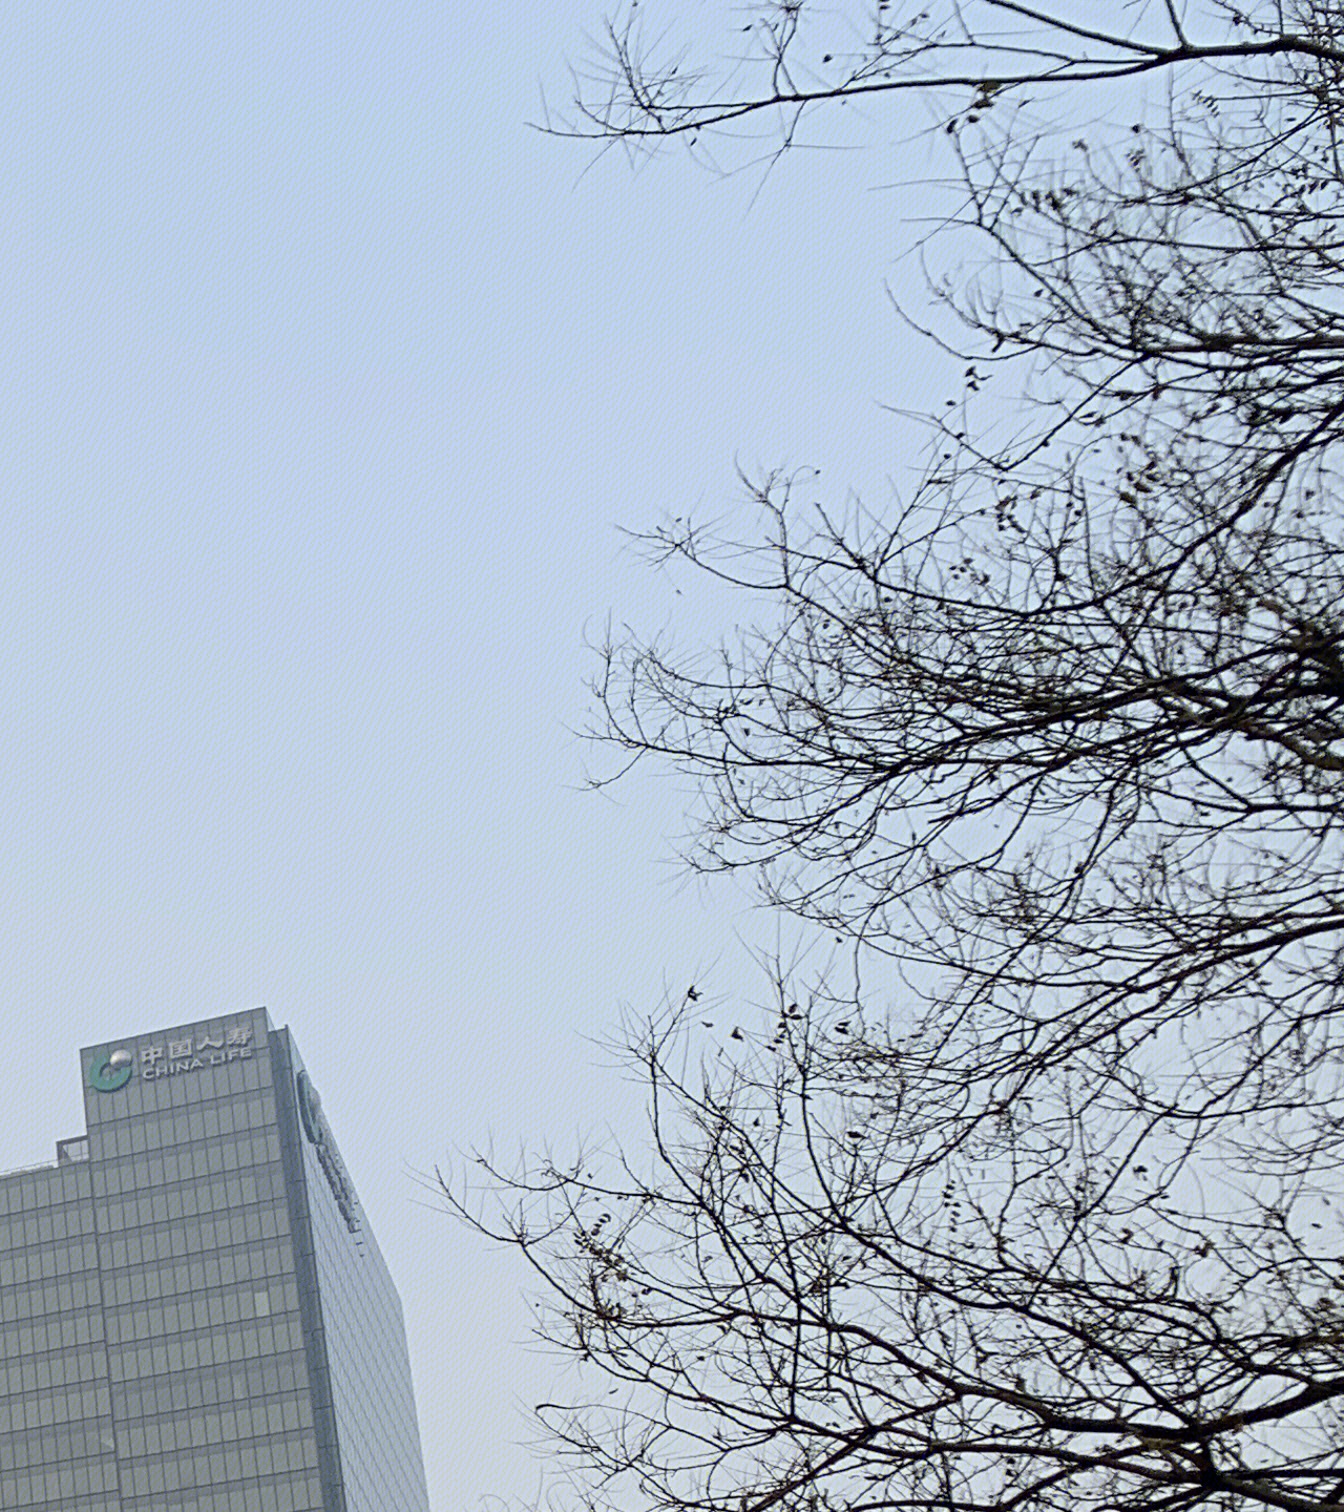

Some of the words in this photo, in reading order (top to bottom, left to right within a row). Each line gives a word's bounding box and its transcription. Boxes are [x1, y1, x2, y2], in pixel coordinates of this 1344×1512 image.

[141, 1026, 253, 1065] 中国人寿
[143, 1058, 204, 1080] CHINA
[210, 1048, 252, 1064] LIFE
